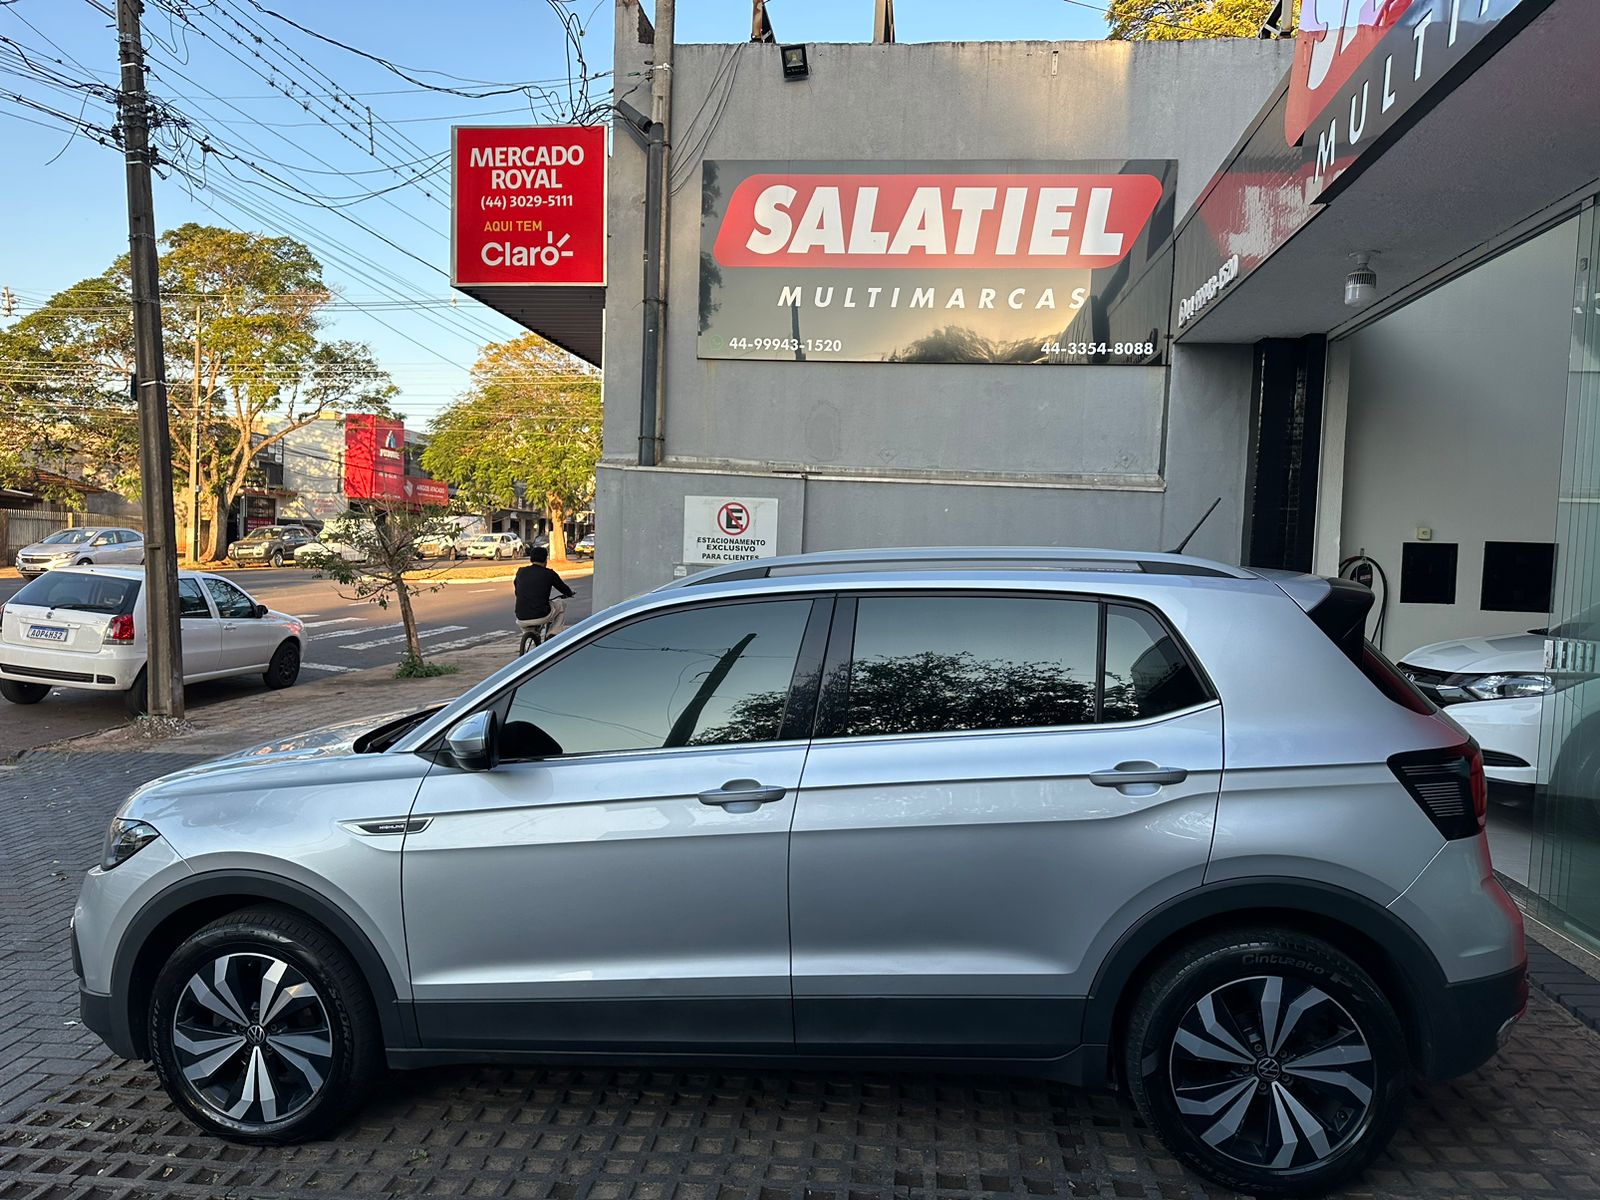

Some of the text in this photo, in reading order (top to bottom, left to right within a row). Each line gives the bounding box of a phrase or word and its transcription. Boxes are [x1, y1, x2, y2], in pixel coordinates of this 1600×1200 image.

[1314, 0, 1489, 184] MULTI
[470, 145, 584, 167] MERCADO
[491, 169, 563, 190] ROYAL
[480, 195, 573, 210] (44) 3029-5111
[483, 220, 543, 232] AQUI TEM
[745, 184, 1124, 256] SALATIEL
[480, 238, 562, 267] Claro
[777, 286, 1087, 309] MULTIMARCAS
[729, 338, 842, 352] 44-99943-1520
[1040, 342, 1154, 355] 44-3354-8088
[697, 537, 766, 545] ESTACIONAMENTO
[706, 544, 756, 552] EXCLUSIVO
